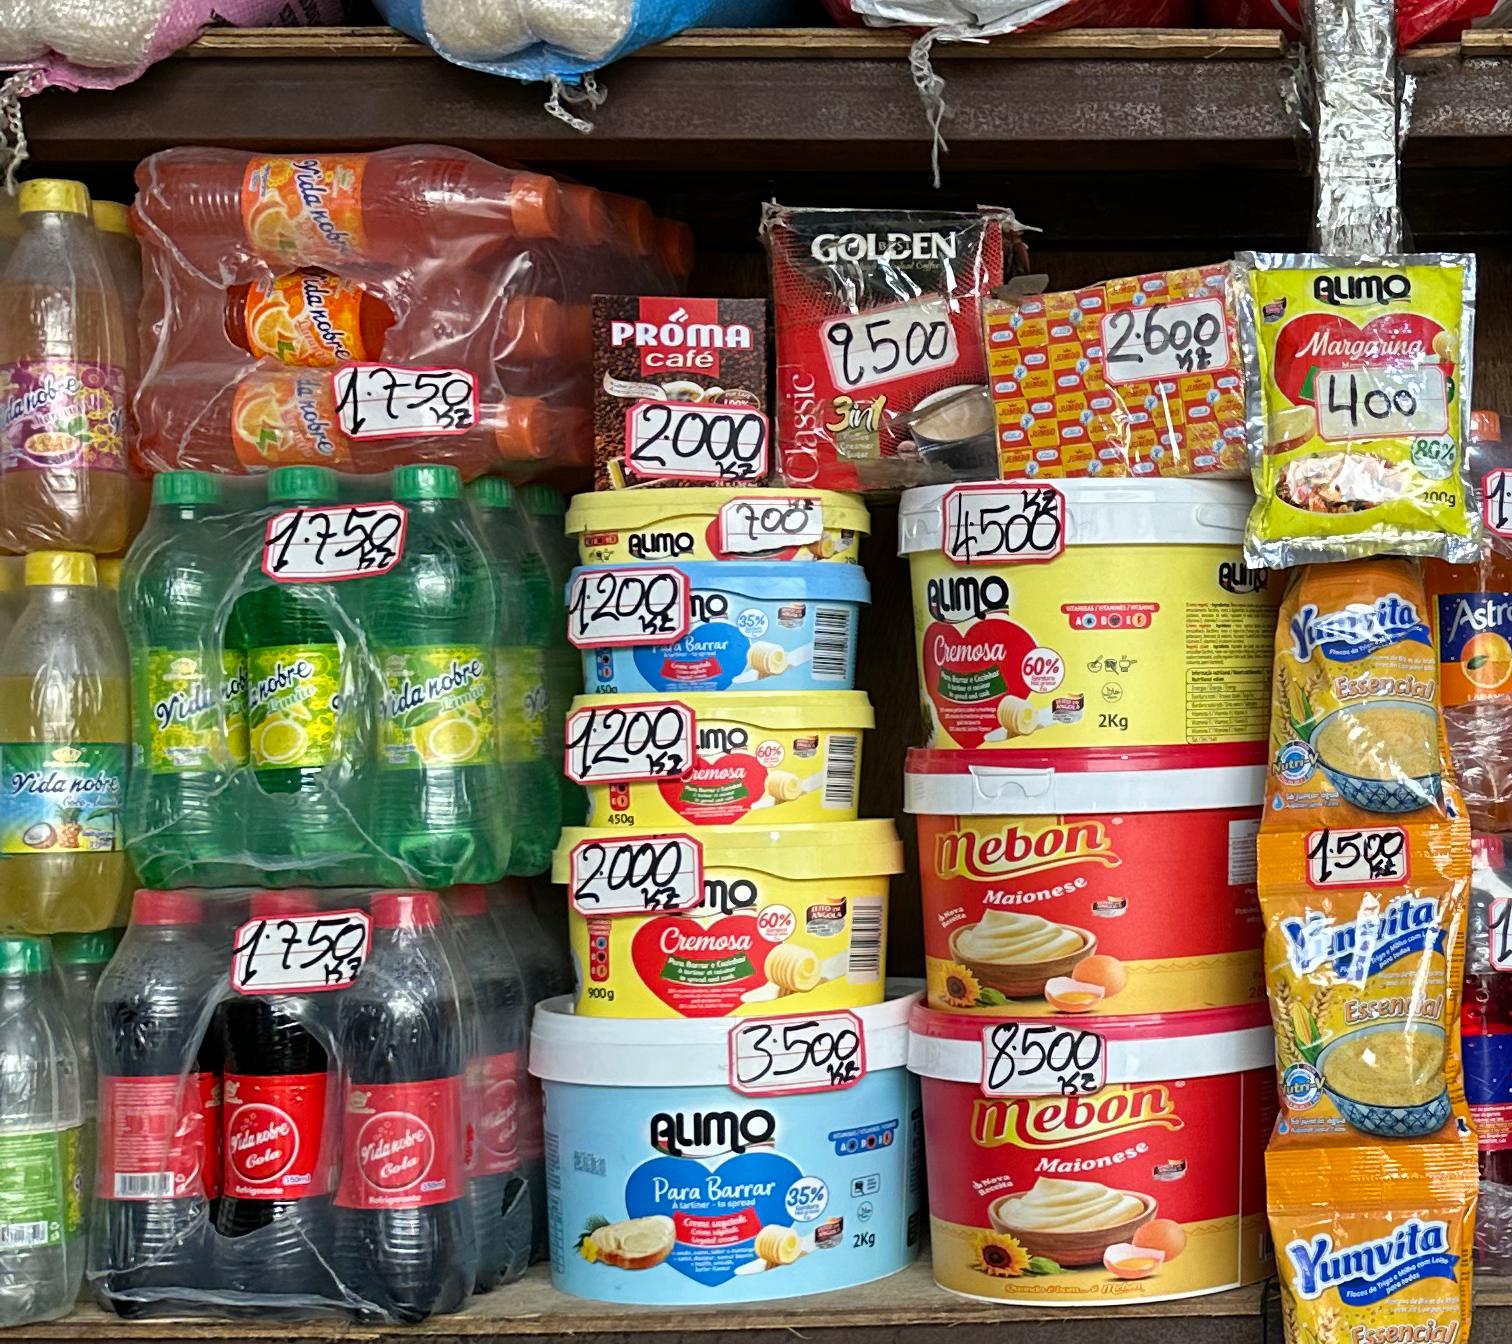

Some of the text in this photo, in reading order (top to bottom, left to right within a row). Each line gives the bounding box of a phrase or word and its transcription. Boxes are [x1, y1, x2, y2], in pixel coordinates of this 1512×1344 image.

[811, 232, 957, 261] GOLDEN
[1106, 303, 1220, 364] 2.600
[644, 348, 715, 370] café
[337, 367, 473, 434] 1.750
[1327, 373, 1418, 428] 400
[631, 403, 766, 461] 2.000
[785, 371, 818, 485] Classic
[265, 509, 401, 572] 1.750
[568, 572, 678, 635] 1.200
[932, 634, 1008, 667] Cremosa
[1022, 655, 1060, 677] 60%
[1333, 673, 1435, 701] Essencial
[1097, 712, 1129, 732] 2Kg
[566, 706, 684, 777] 1.200
[607, 813, 635, 827] 450g
[574, 840, 682, 903] 2.000
[980, 873, 1089, 906] Maionese
[757, 911, 793, 929] 60%
[233, 916, 366, 986] 1.750
[658, 926, 753, 955] Cremosa
[587, 986, 615, 1002] 900g
[736, 1020, 860, 1084] 3.500
[989, 1022, 1102, 1090] 8.500
[1033, 1141, 1151, 1175] Maionese
[653, 1176, 777, 1203] Para Barrar
[785, 1185, 825, 1207] 35%
[852, 1232, 876, 1249] 2Kg
[1288, 1221, 1449, 1298] Yumvita
